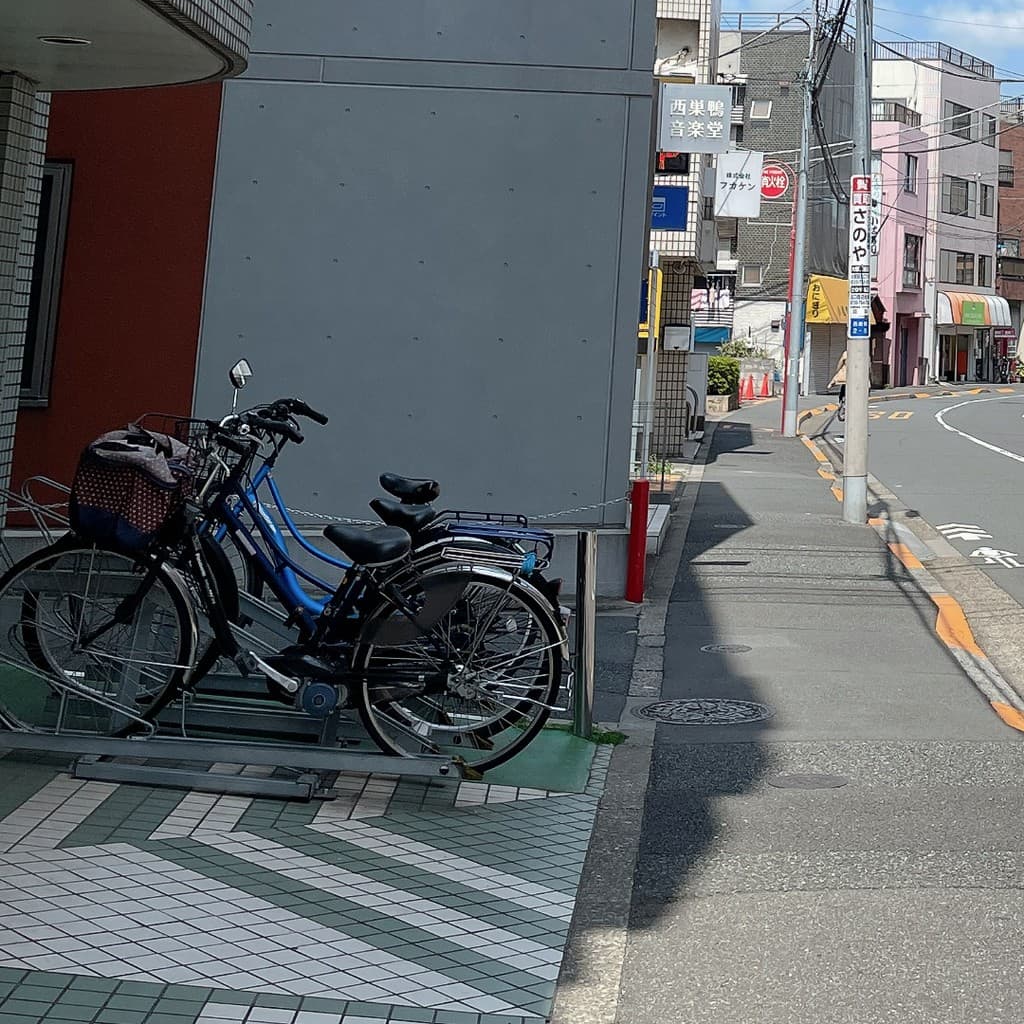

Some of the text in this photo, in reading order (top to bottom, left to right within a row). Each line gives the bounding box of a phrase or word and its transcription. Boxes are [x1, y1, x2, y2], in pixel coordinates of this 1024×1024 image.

[670, 98, 725, 118] 西巣鴨
[670, 120, 724, 139] 音楽堂
[852, 208, 867, 262] さのや
